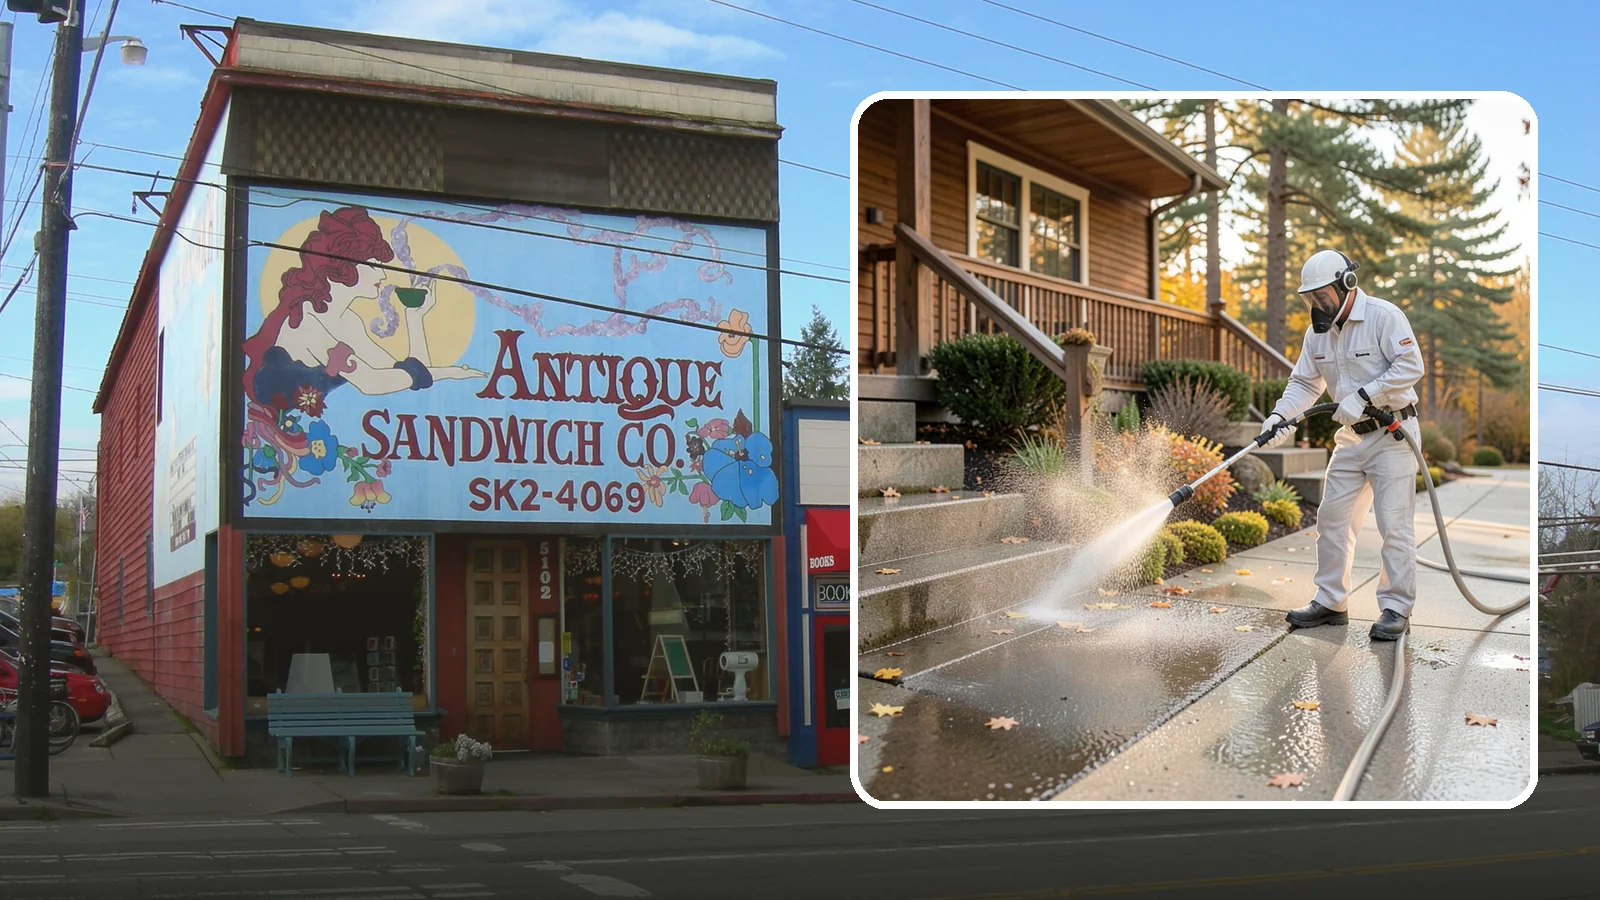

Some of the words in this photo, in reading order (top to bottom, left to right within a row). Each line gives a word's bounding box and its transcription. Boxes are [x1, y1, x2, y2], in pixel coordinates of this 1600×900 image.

[475, 329, 723, 420] ANTIQUE
[361, 408, 604, 467] SANDWICH
[617, 421, 685, 468] CO.
[468, 477, 646, 513] SK2-4069
[539, 541, 552, 600] 5102
[809, 555, 835, 569] BOOKS
